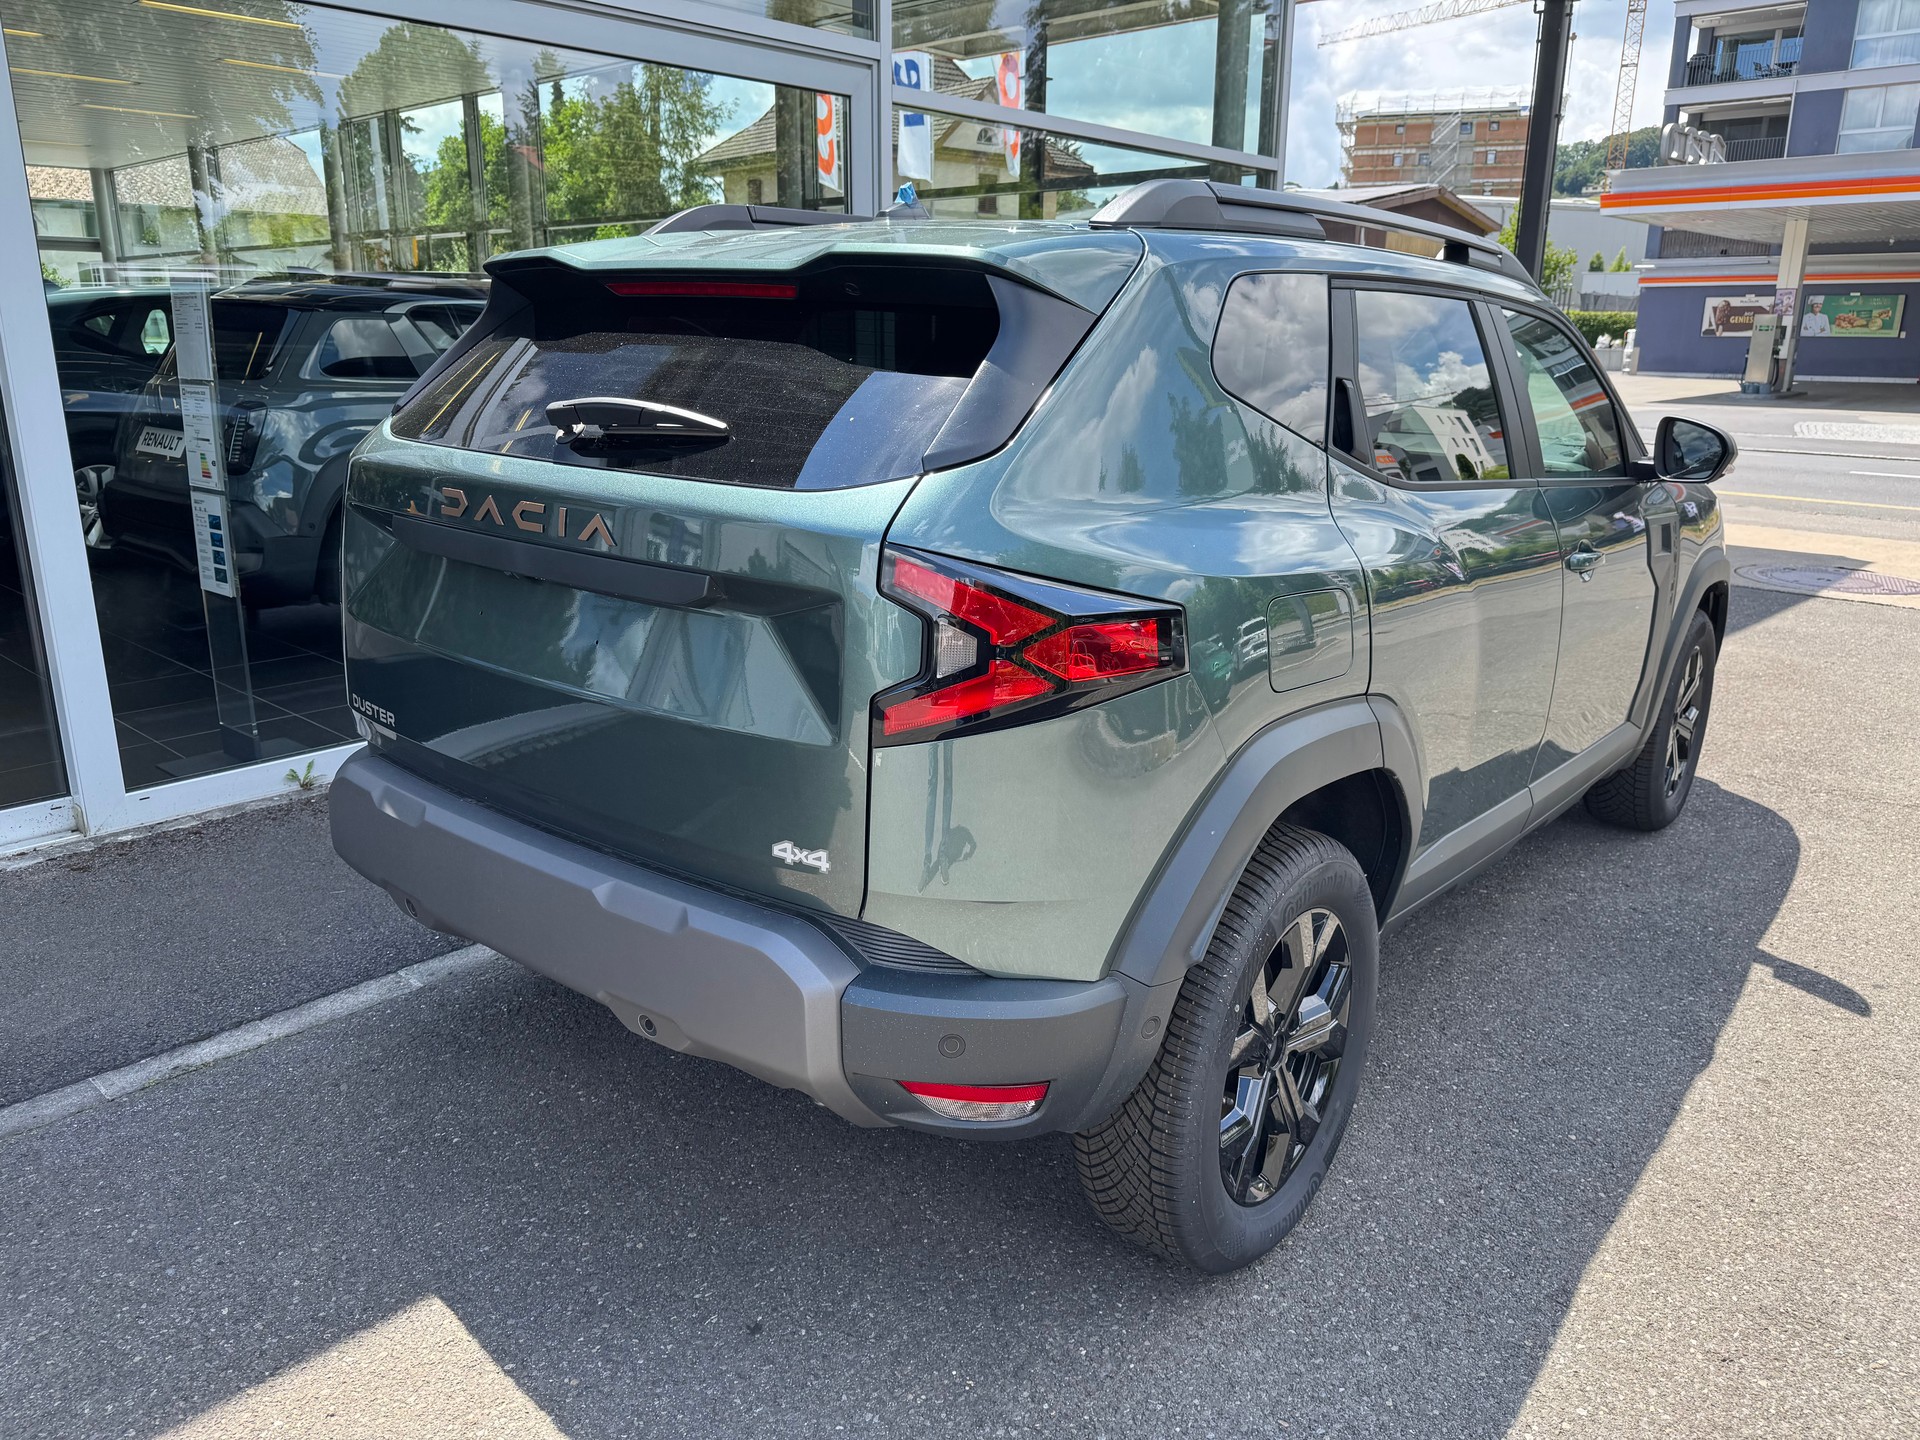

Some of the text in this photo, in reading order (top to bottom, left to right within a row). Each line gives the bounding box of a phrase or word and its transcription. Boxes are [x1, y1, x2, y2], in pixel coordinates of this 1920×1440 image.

[141, 431, 183, 452] RENAULT
[440, 487, 617, 546] DACIA
[352, 693, 396, 727] DUSTER
[772, 840, 831, 874] 4x4
